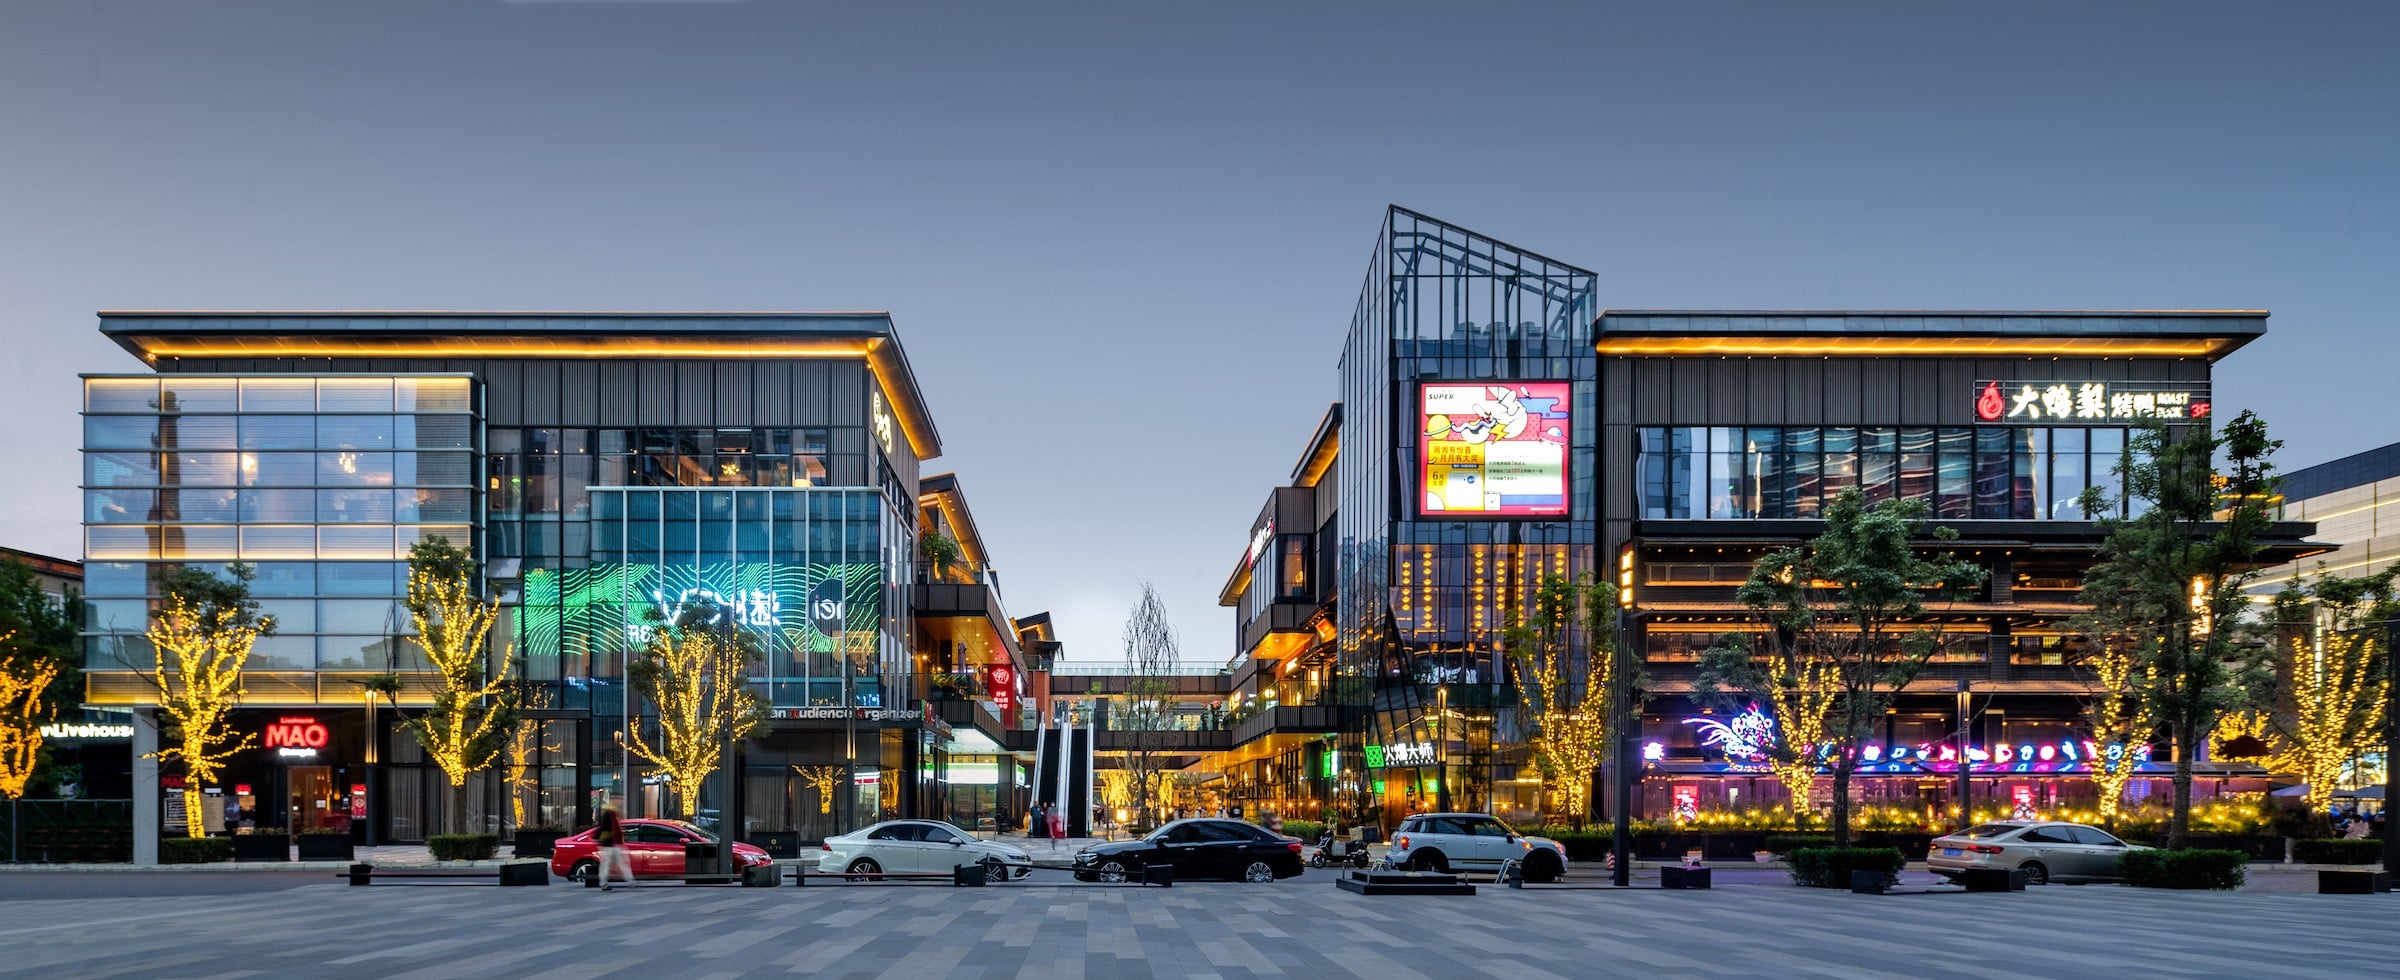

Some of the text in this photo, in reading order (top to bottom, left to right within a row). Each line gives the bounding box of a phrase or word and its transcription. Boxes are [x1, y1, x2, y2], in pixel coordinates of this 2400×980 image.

[2007, 383, 2107, 419] 大鸭梨
[2156, 392, 2190, 405] ROAST
[2191, 402, 2211, 418] 3F
[1432, 470, 1445, 481] 6月
[790, 707, 852, 720] Audience
[855, 708, 921, 721] Organizer
[265, 724, 328, 748] MAO
